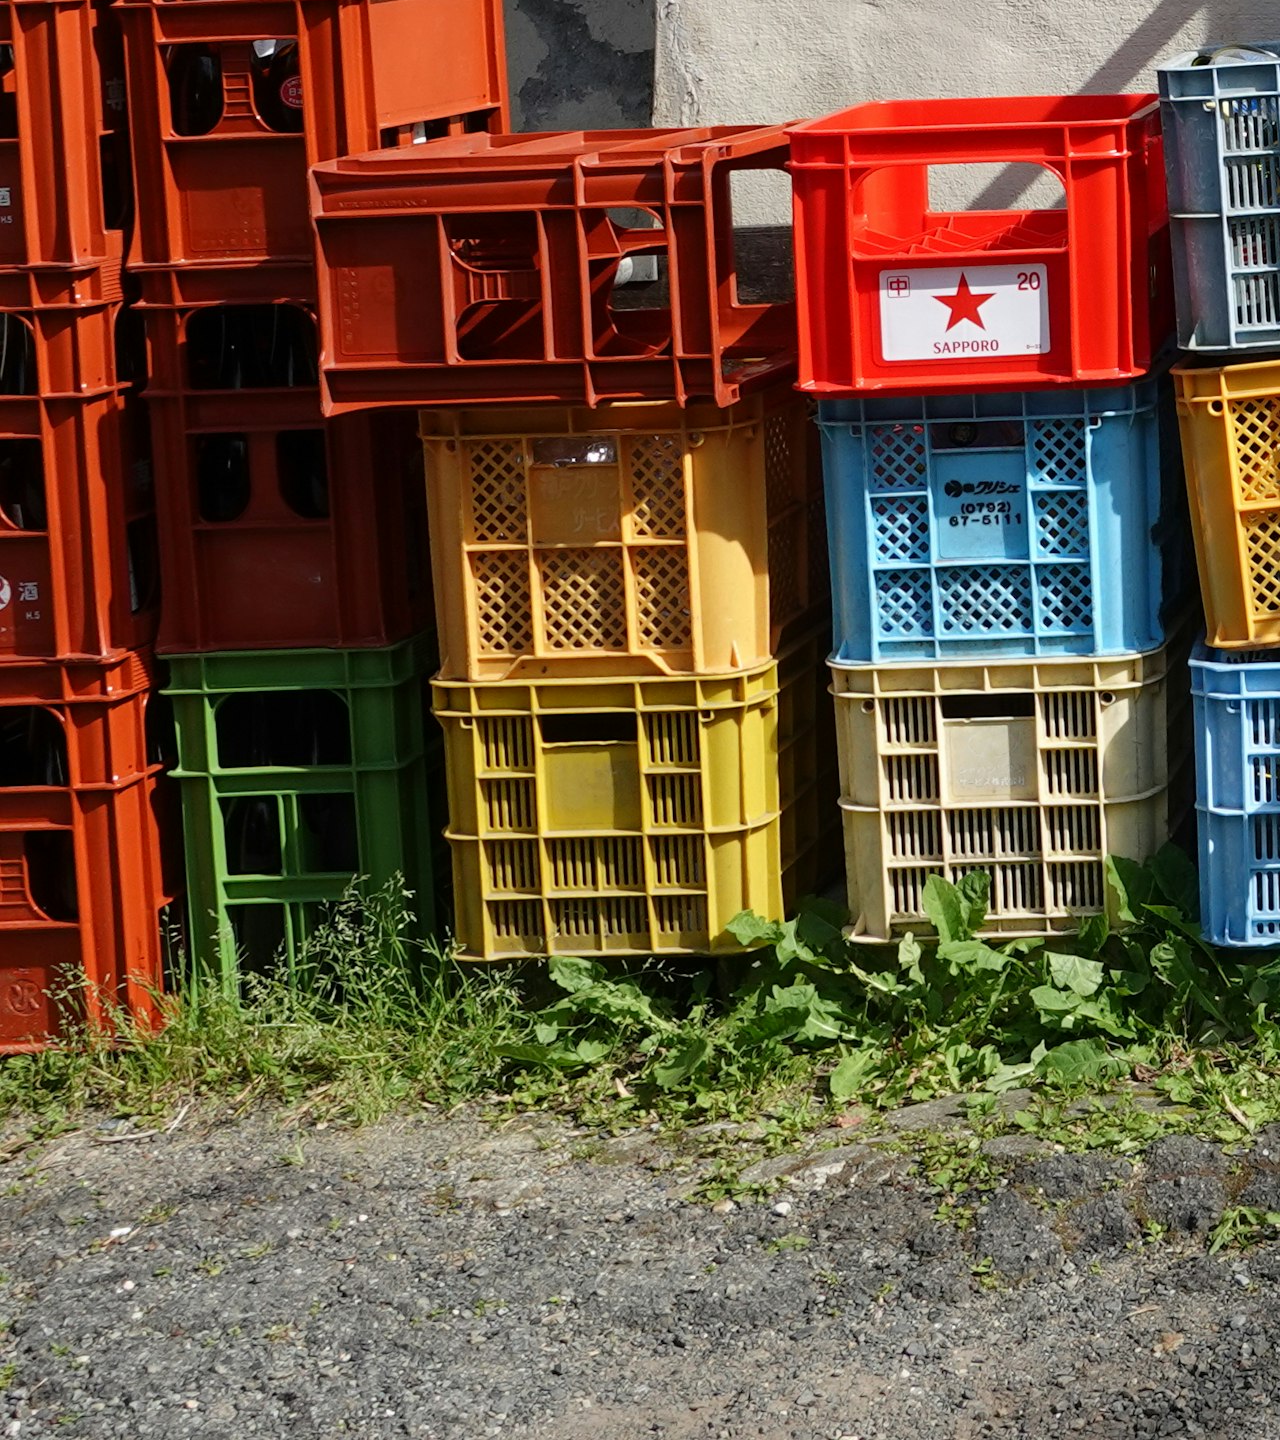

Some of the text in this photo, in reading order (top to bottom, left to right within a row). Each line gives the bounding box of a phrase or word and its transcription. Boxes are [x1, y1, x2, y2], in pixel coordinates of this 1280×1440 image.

[889, 278, 908, 296] 中
[1017, 271, 1041, 291] 20
[933, 339, 999, 355] SAPPORO
[963, 481, 1021, 495] クリシェ
[961, 500, 1011, 514] (0792)
